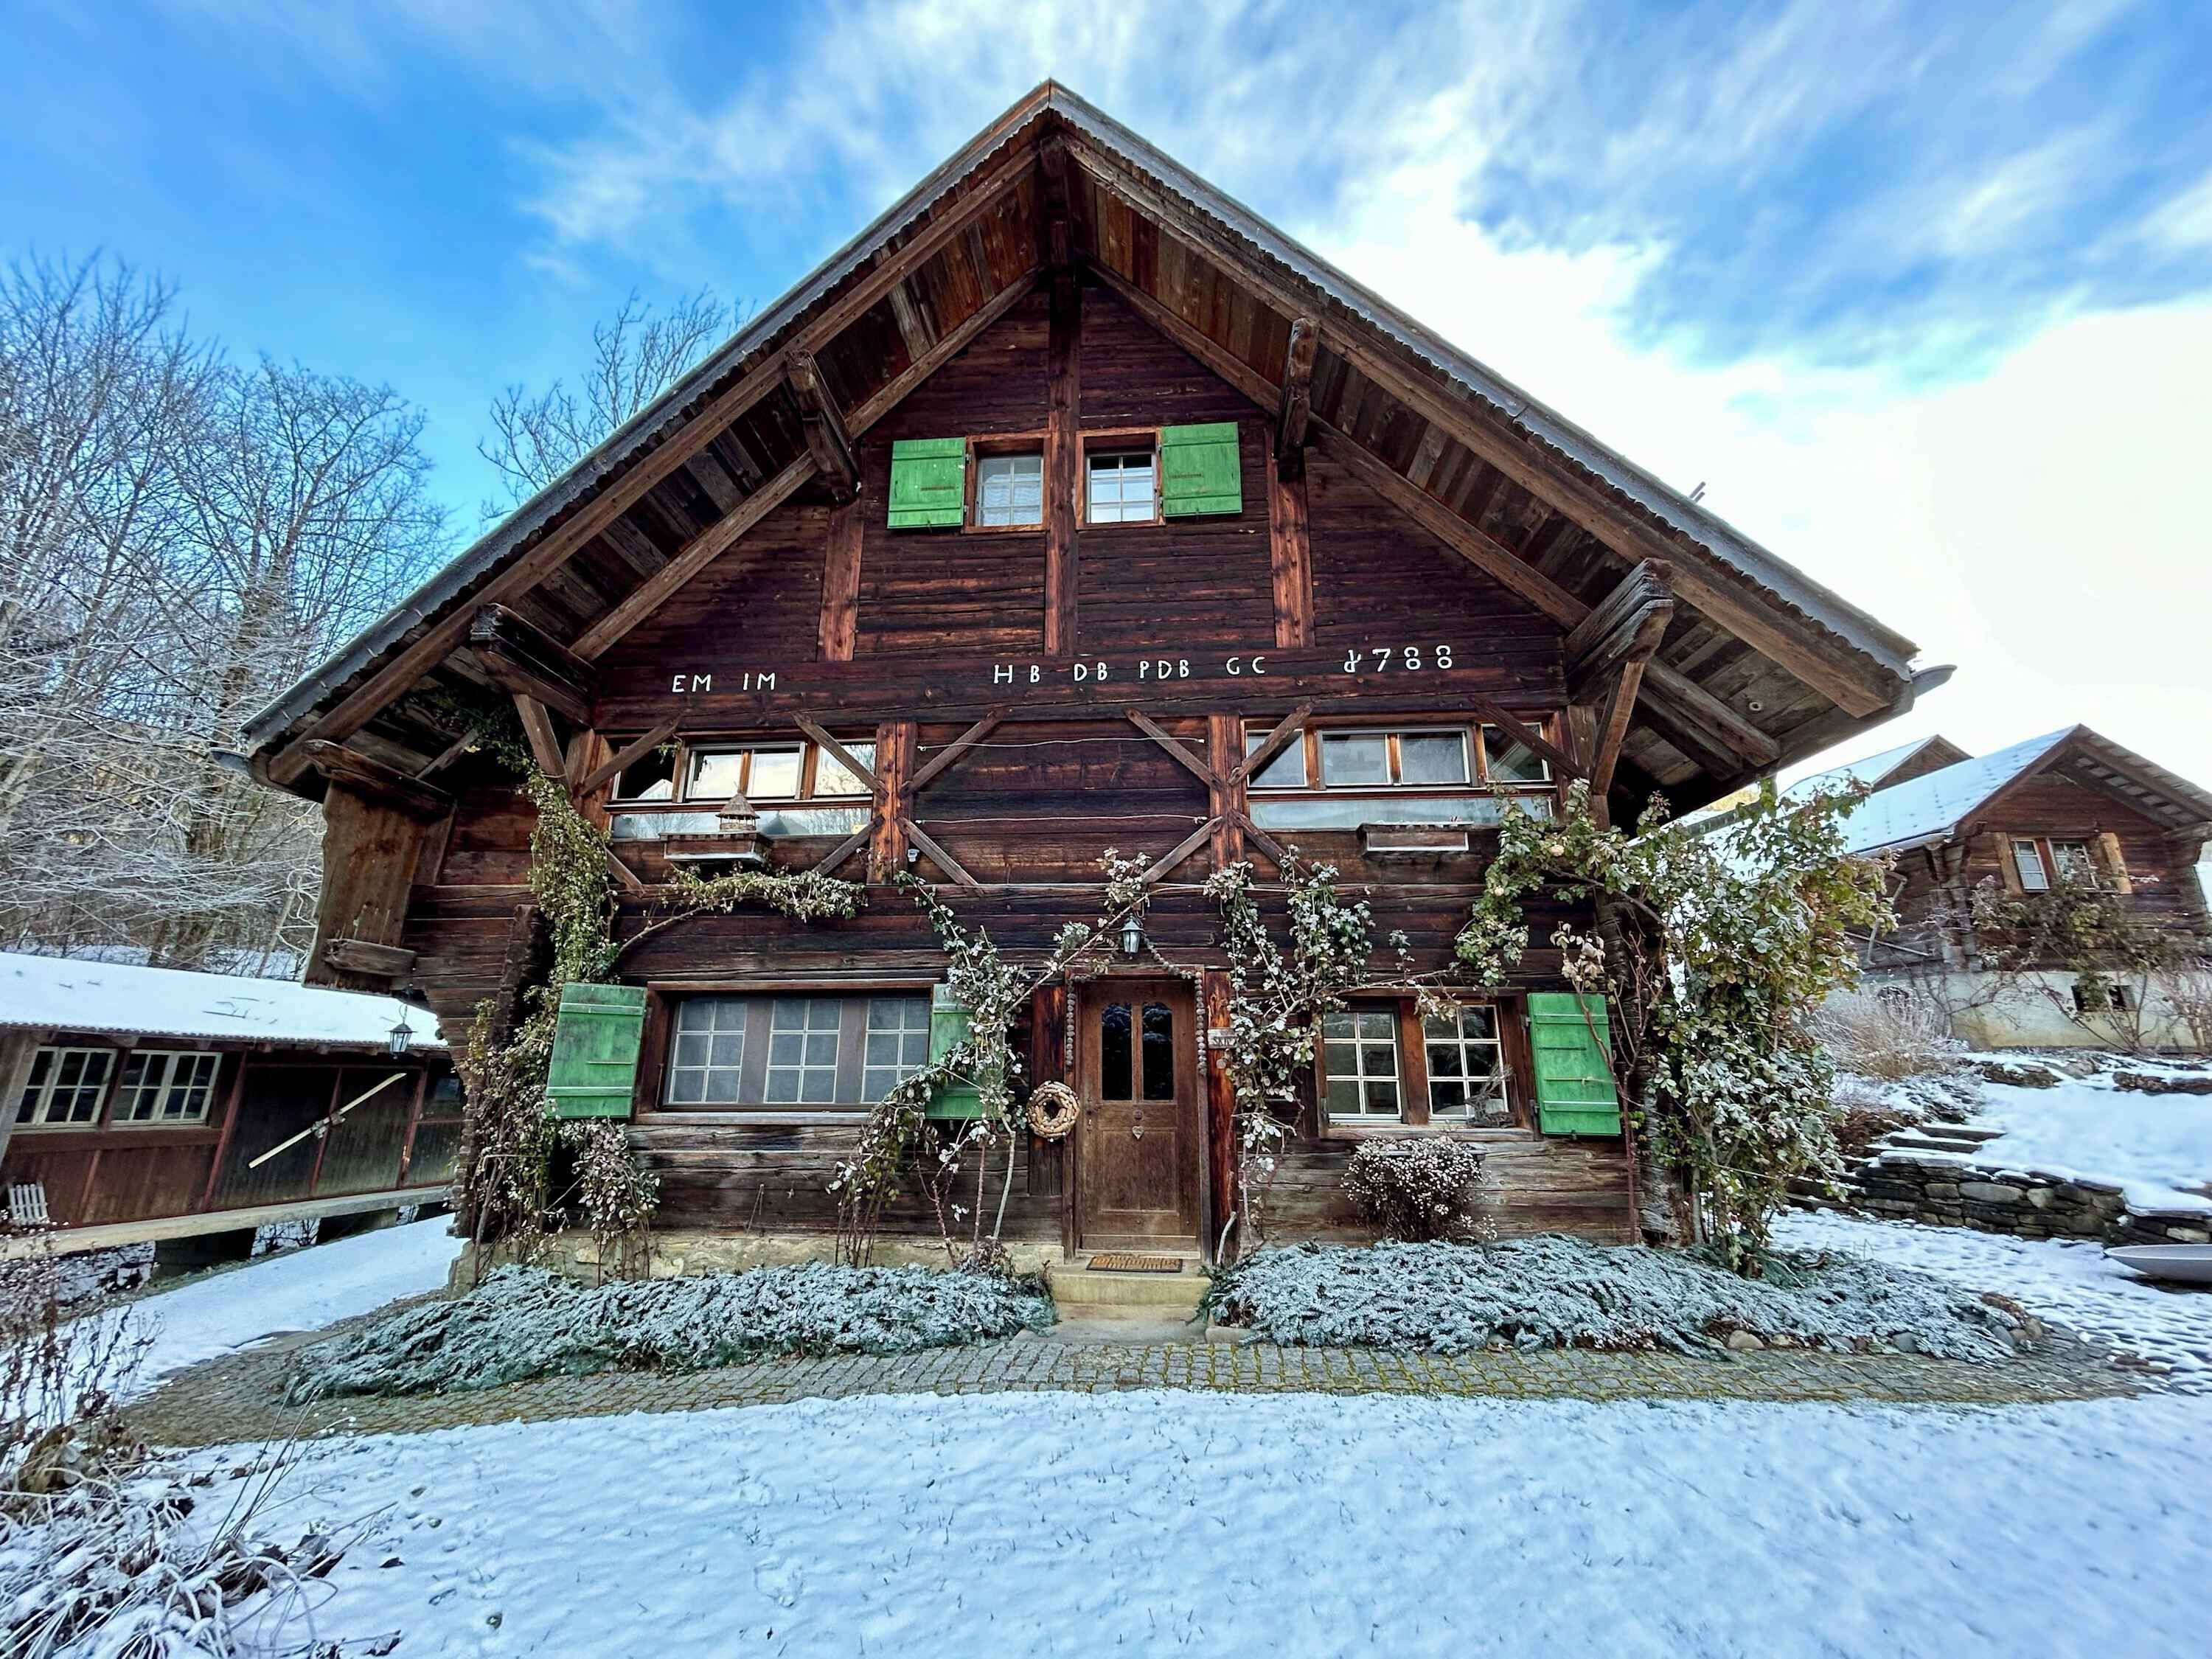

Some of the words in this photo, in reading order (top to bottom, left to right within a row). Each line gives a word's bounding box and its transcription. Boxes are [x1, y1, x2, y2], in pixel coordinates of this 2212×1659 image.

[672, 675, 712, 692] EM
[1074, 661, 1108, 681] DB
[1139, 659, 1190, 678] PDB
[1225, 657, 1266, 675] GC
